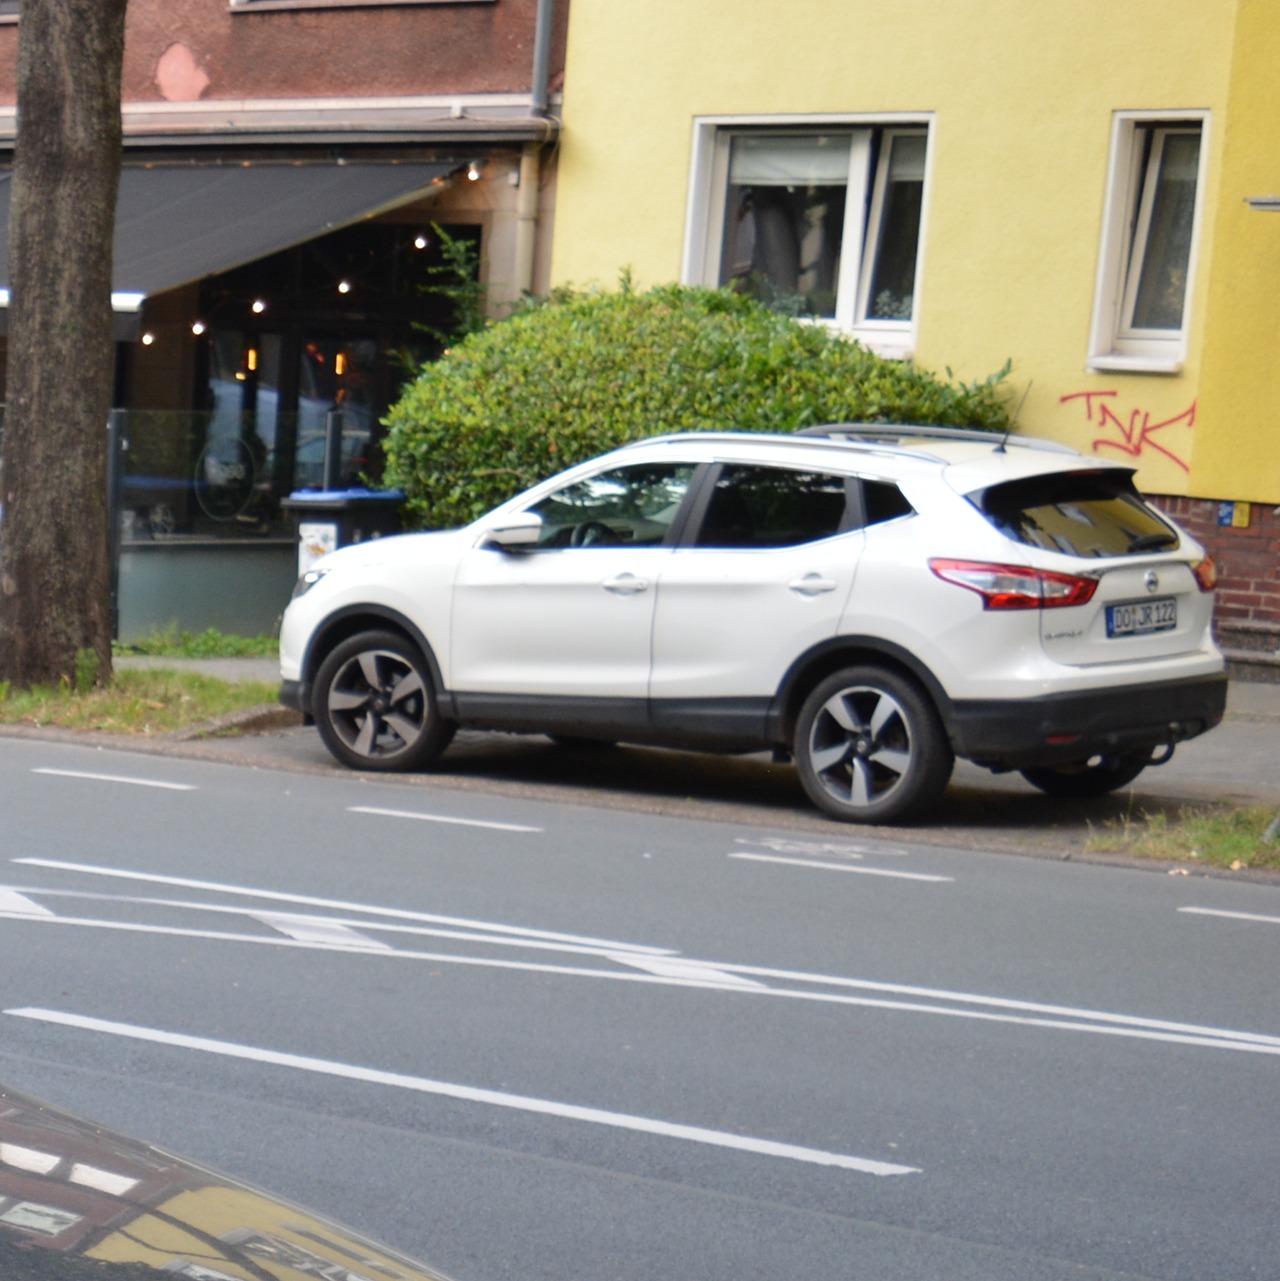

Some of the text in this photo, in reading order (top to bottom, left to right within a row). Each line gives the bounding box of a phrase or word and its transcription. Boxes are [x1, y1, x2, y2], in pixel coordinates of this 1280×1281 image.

[1115, 602, 1174, 629] DO JR 122
